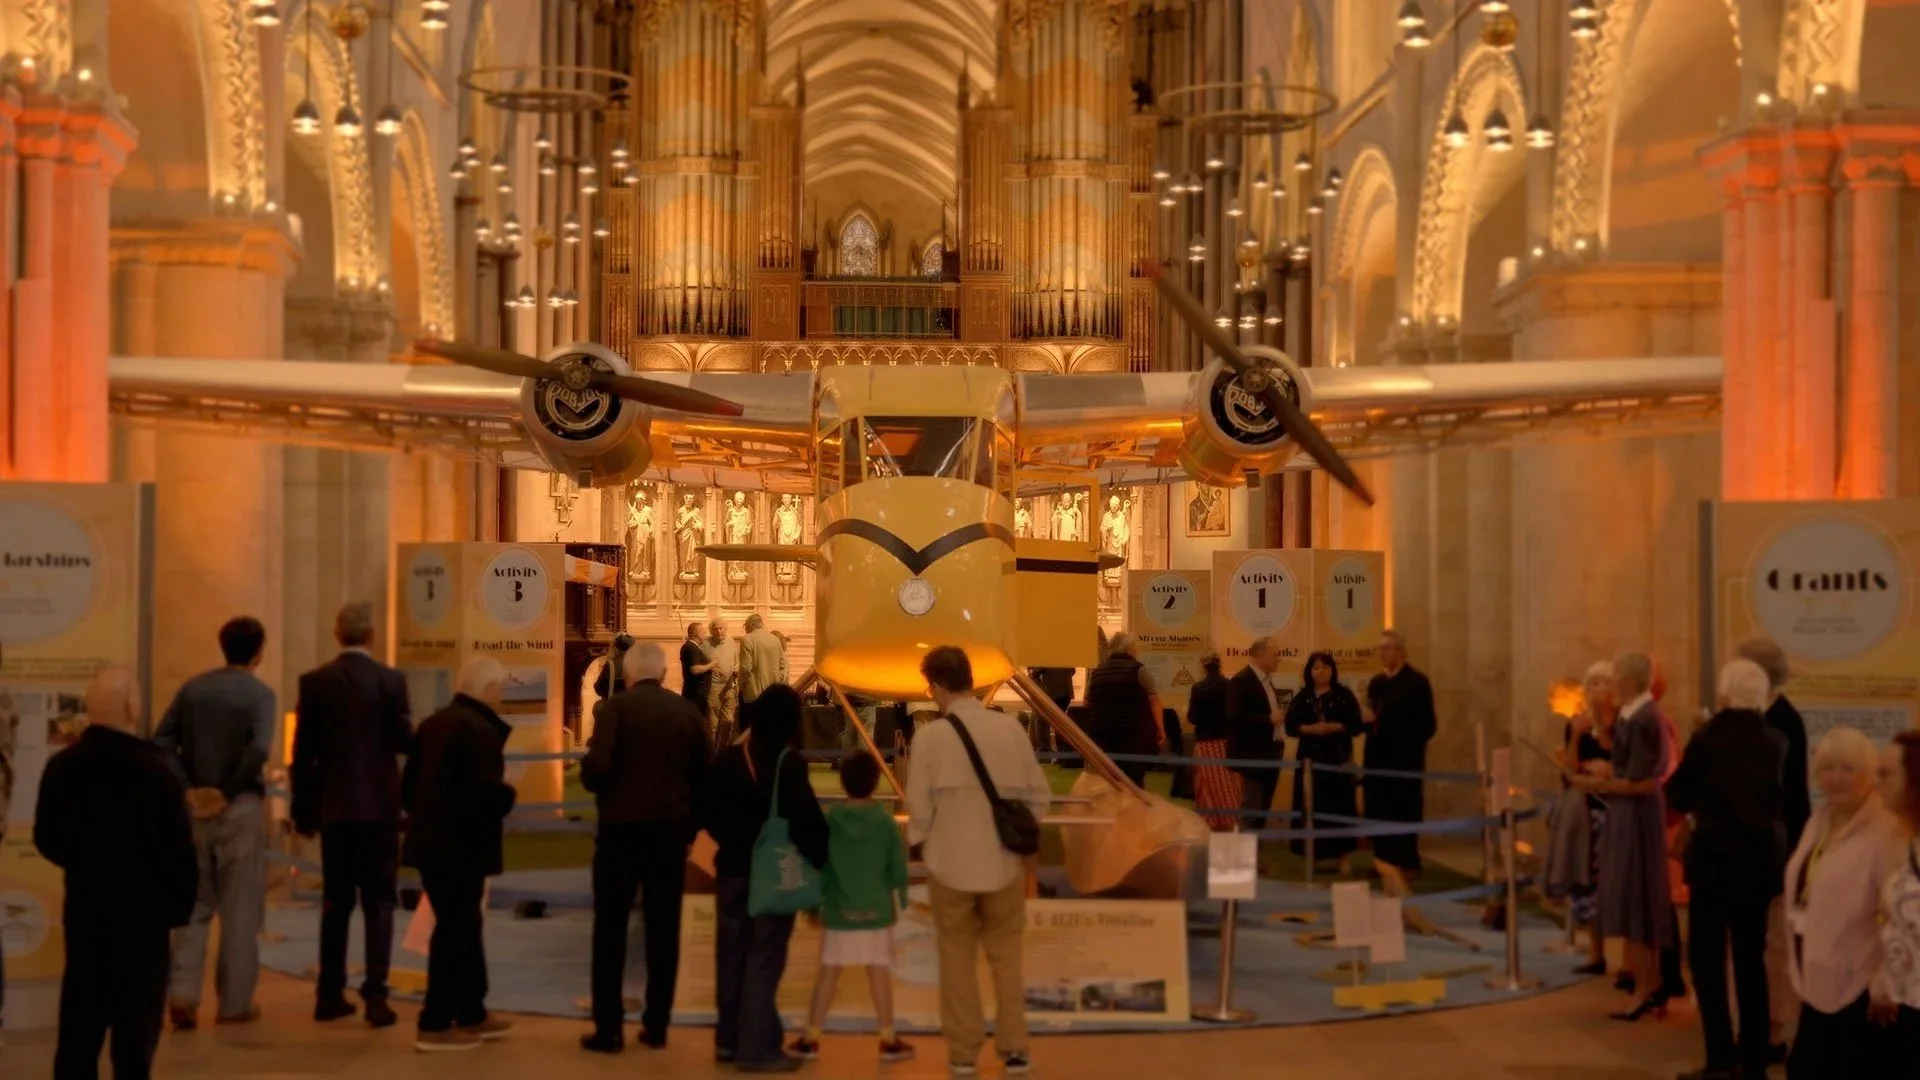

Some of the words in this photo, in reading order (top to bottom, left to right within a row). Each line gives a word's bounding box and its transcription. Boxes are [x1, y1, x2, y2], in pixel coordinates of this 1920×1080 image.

[494, 566, 538, 578] Activity
[1240, 573, 1284, 585] Activity
[1333, 573, 1367, 585] Activity
[1767, 568, 1888, 591] Grants
[507, 580, 523, 602] 3
[1152, 585, 1188, 593] Activity
[1162, 594, 1176, 609] 2
[1256, 587, 1266, 609] 1
[1345, 587, 1353, 609] 1
[473, 640, 503, 650] Read
[506, 640, 524, 650] the
[526, 640, 553, 650] Wind
[1138, 635, 1167, 643] Strong
[1168, 635, 1200, 643] Shapes
